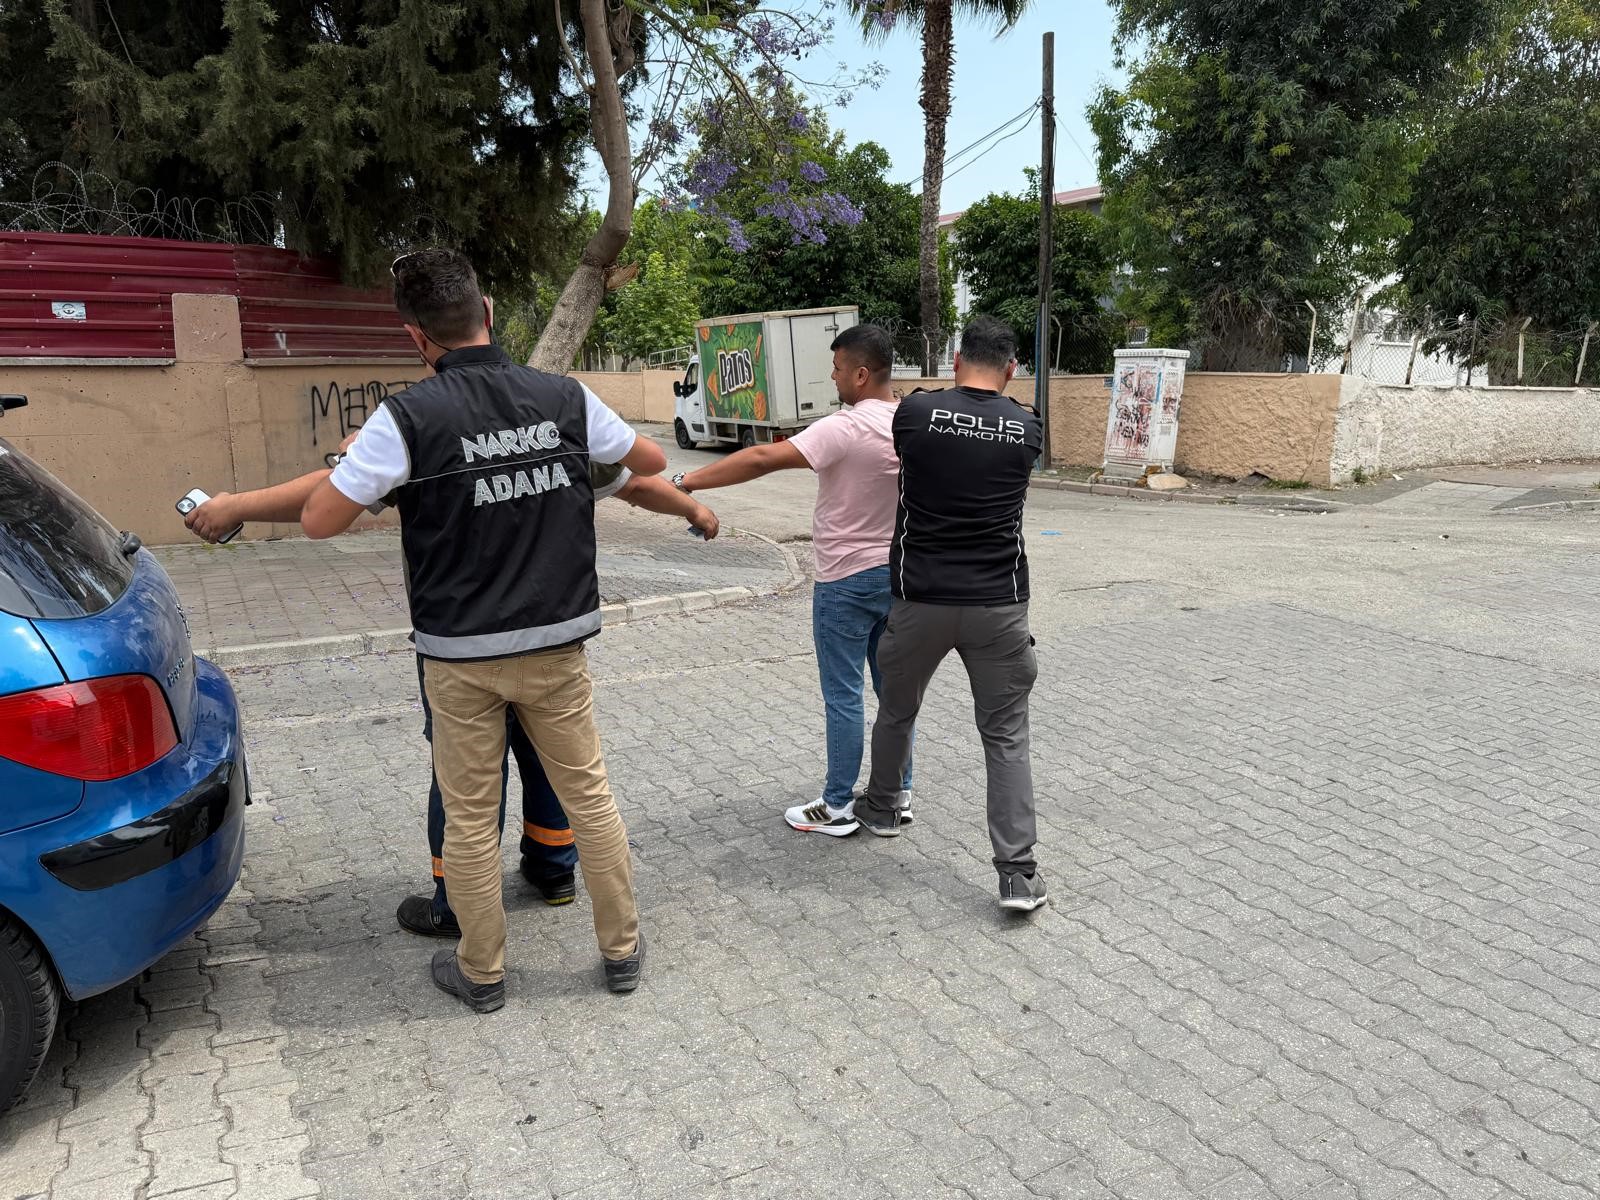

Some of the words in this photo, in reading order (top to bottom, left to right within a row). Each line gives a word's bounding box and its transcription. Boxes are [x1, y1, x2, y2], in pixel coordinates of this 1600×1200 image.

[928, 424, 1025, 445] NARKOTİM
[930, 409, 1025, 435] POLİS
[460, 421, 562, 463] NARKO
[474, 462, 571, 507] ADANA
